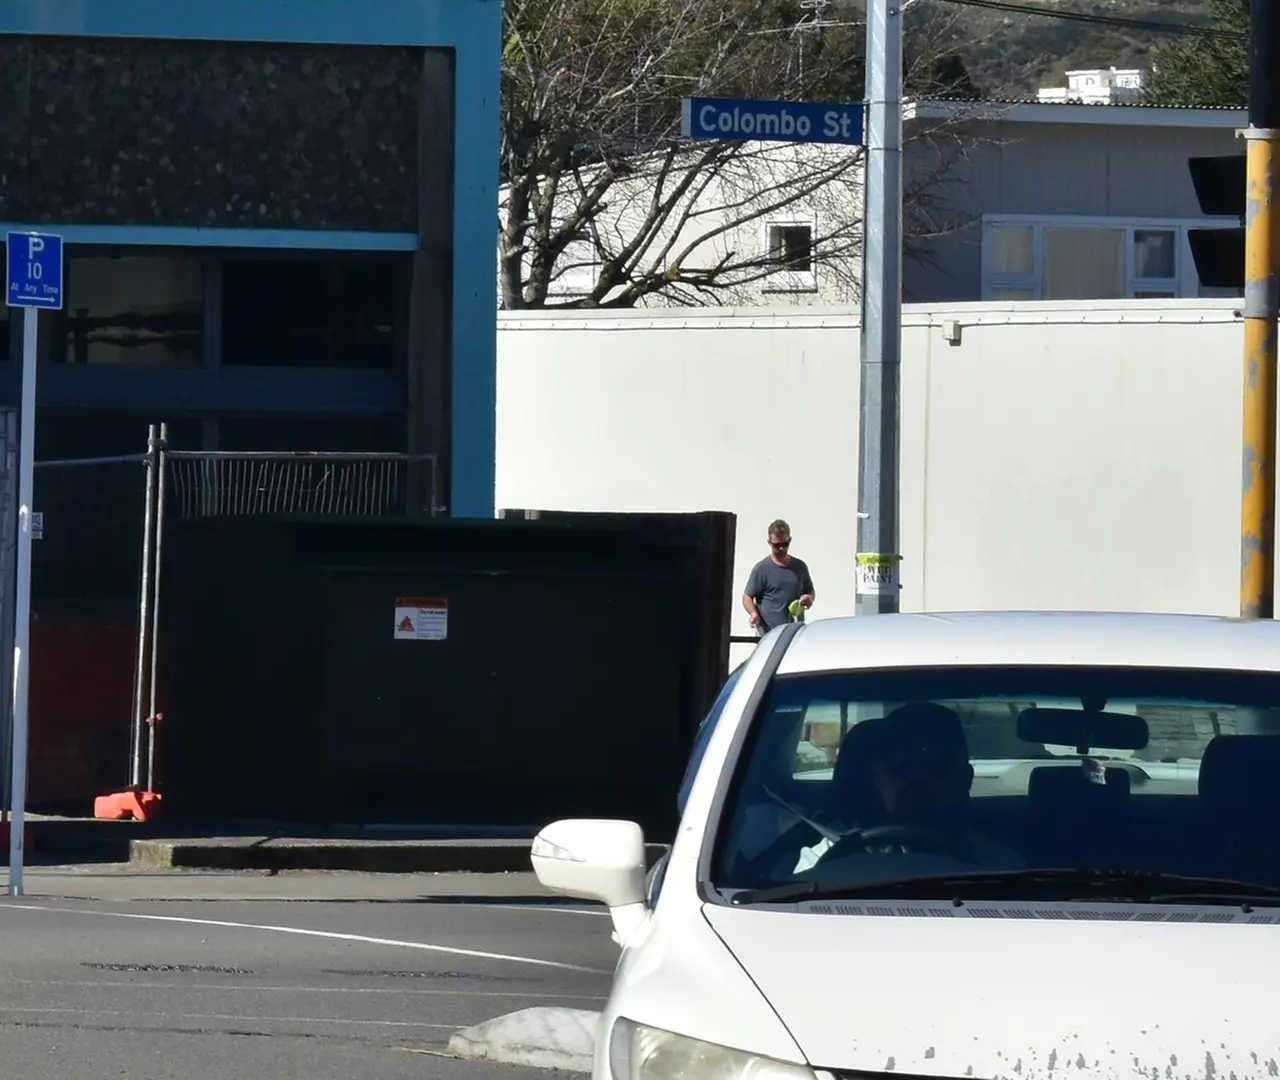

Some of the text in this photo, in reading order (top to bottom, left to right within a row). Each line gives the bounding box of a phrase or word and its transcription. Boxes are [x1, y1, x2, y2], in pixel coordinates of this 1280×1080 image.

[700, 105, 852, 138] Colombo St
[28, 237, 45, 259] P
[27, 262, 42, 279] 10
[10, 282, 59, 295] At Any Time
